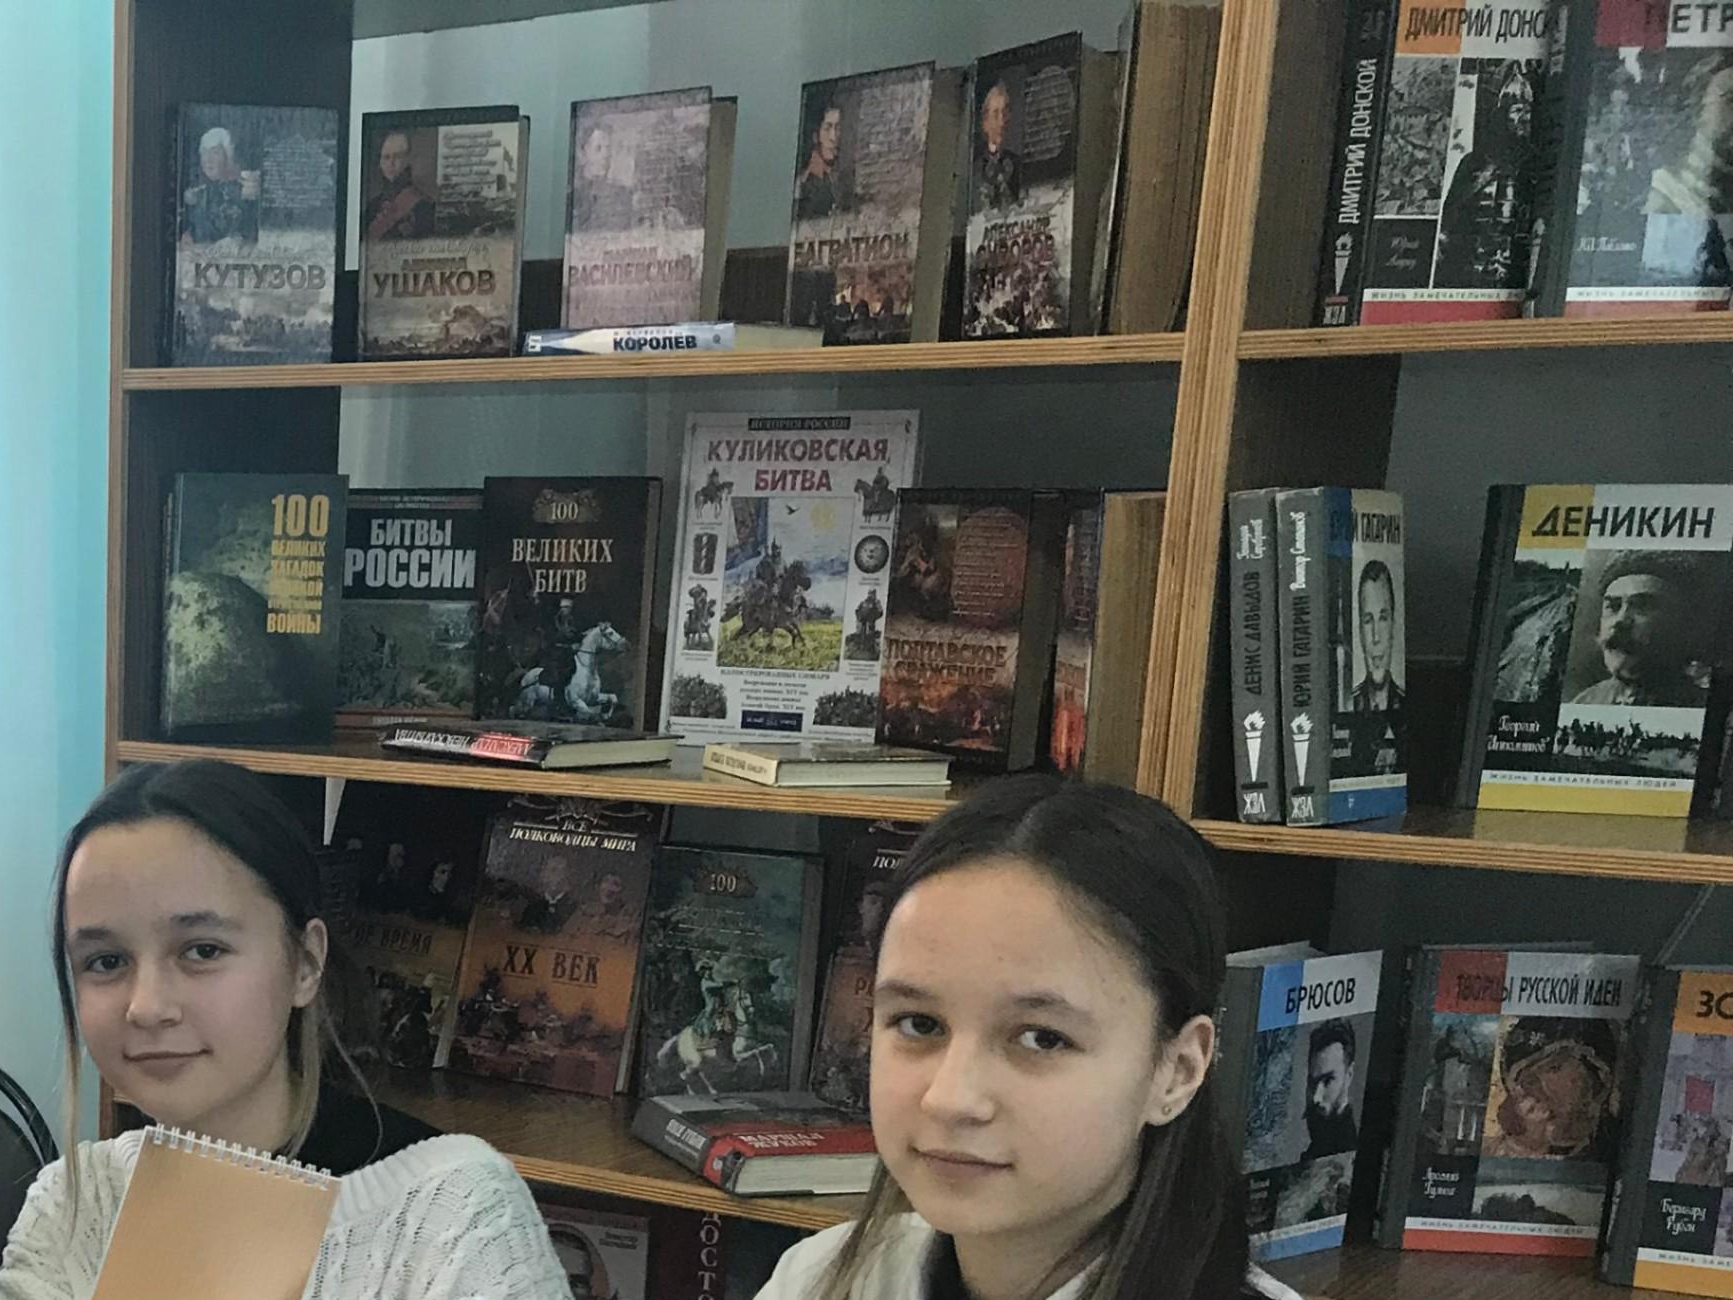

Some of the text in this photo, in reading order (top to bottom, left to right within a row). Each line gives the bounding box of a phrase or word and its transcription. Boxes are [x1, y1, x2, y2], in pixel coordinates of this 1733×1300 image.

[1406, 5, 1493, 41] ДМИТРИЙ
[1496, 9, 1558, 43] ДОНС
[1349, 58, 1378, 138] ДОНСКОЙ
[1338, 143, 1367, 224] ДМИТРИЙ
[795, 232, 910, 266] БАГРАТИОН
[194, 263, 326, 290] КУТУЗОВ
[373, 270, 497, 298] УШАКОВ
[613, 334, 697, 351] КОРОЛЕВ
[707, 436, 890, 463] КУЛИКОВСКАЯ
[754, 468, 832, 493] БИТВА
[271, 493, 330, 537] 100
[549, 501, 580, 521] 100
[1531, 505, 1716, 540] ДЕНИКИН
[370, 518, 453, 546] БИТВЫ
[511, 538, 615, 564] ВЕЛИКИХ
[344, 547, 477, 588] РОССИИ
[533, 568, 587, 593] БИТВ
[1243, 571, 1263, 642] ДАВЫДОВ
[267, 612, 321, 635] ВОЙНЫ
[885, 637, 1008, 667] ПОЛТАВСКОЕ
[1291, 594, 1312, 707] ЮРИЙ ГАГАРИН
[1242, 645, 1263, 696] ДЕНИС
[509, 827, 637, 852] ПОЛКОВОДЦЫ МИРА
[562, 820, 587, 833] ВСЕ
[709, 873, 738, 893] 100
[552, 949, 601, 985] ВЕК
[1284, 976, 1357, 1016] БРЮСОВ
[1517, 974, 1581, 1006] РУССКОЙ
[1583, 978, 1623, 1007] ИДЕИ
